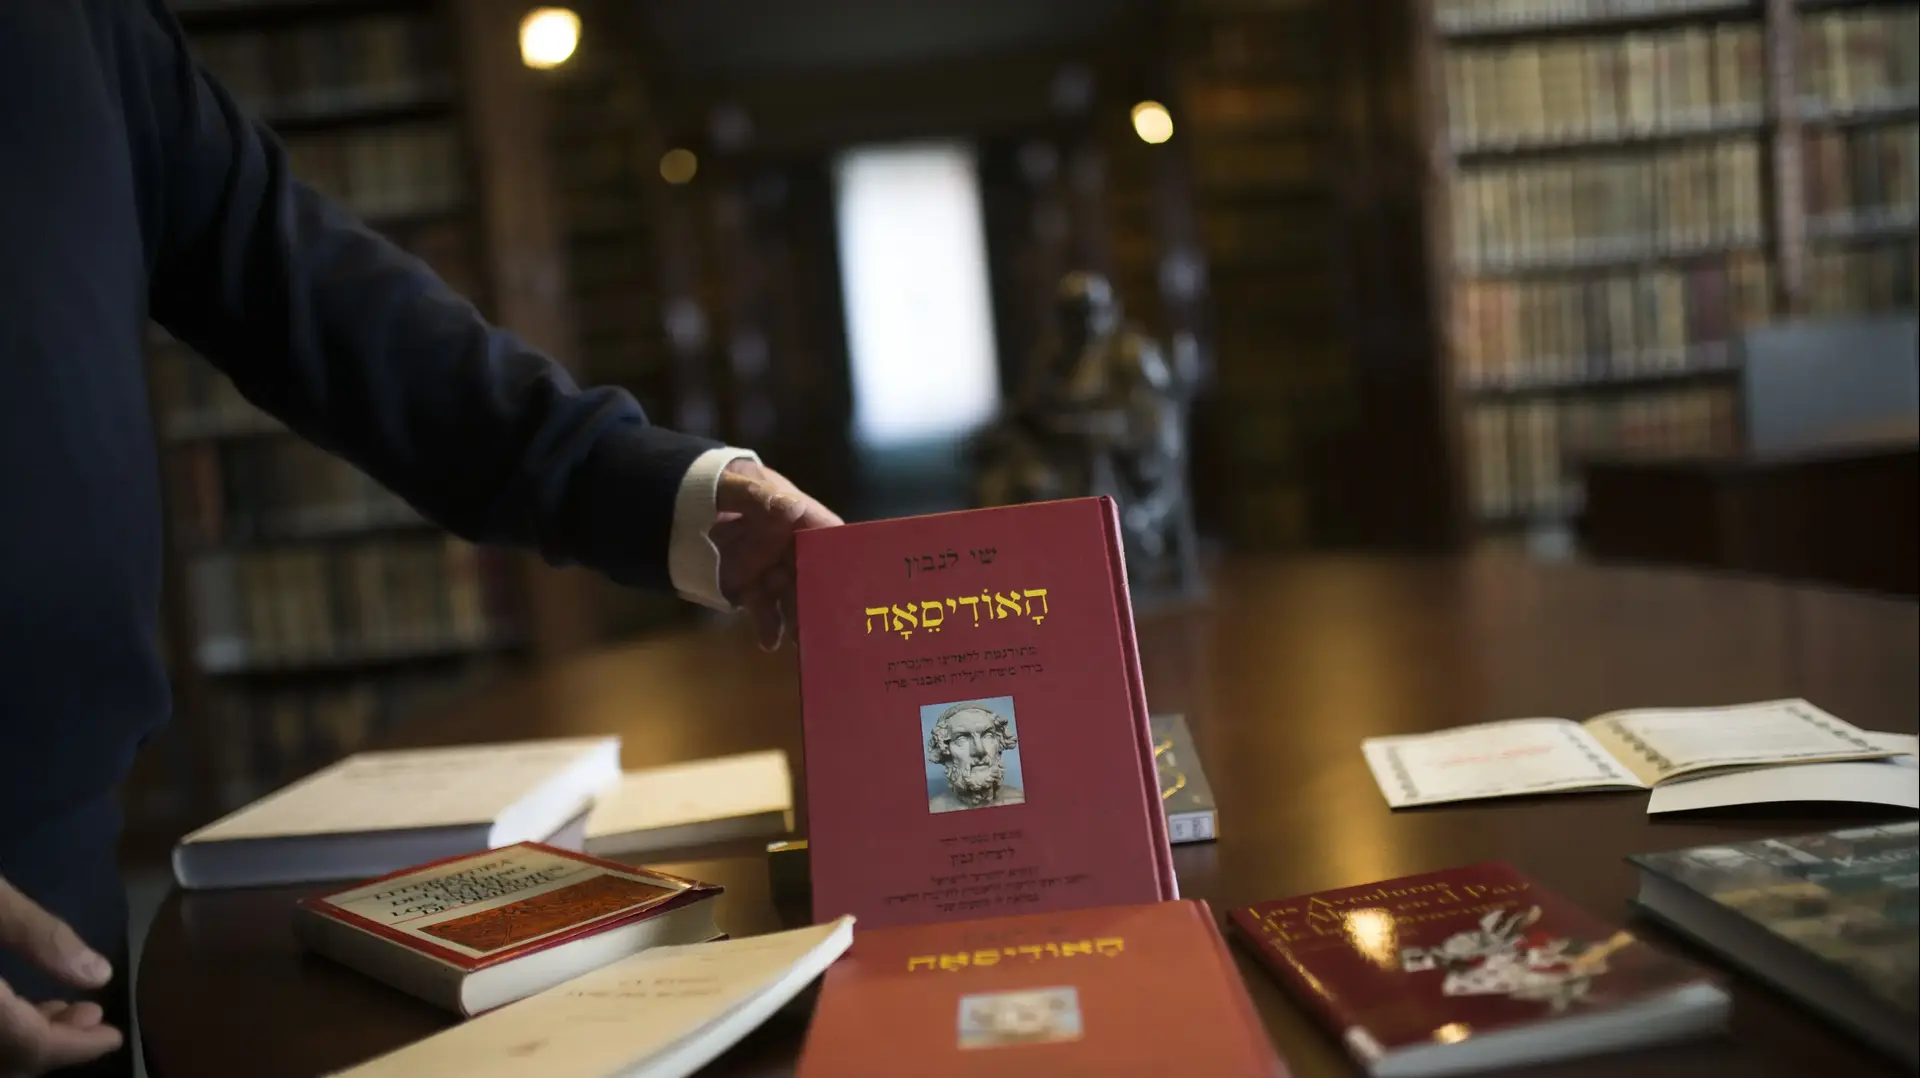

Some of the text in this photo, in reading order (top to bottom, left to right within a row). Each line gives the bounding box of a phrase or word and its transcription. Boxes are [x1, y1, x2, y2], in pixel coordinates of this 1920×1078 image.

[904, 547, 998, 579] שי לנבון
[989, 666, 1017, 678] משה
[1020, 662, 1044, 675] בידי
